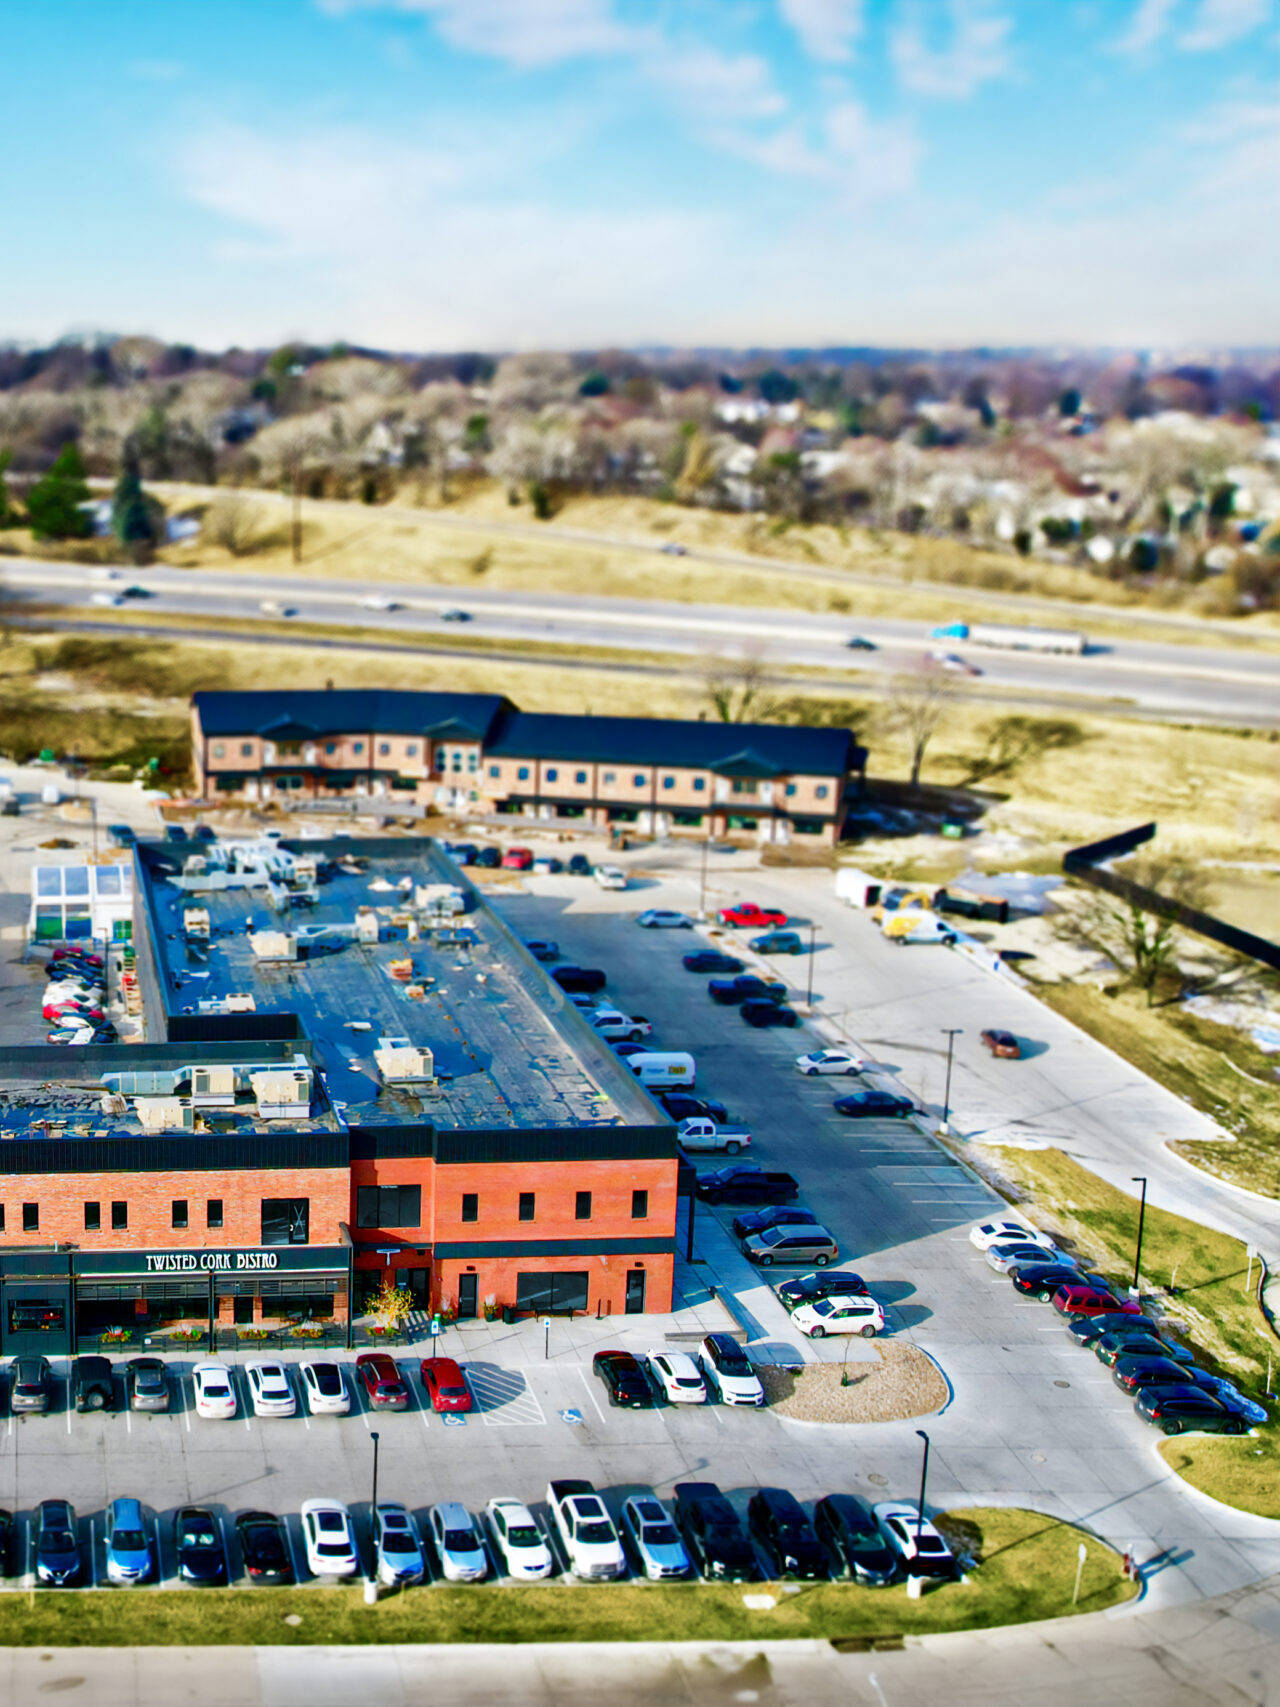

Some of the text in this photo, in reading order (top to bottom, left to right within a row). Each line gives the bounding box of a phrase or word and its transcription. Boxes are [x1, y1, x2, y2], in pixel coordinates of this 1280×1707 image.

[146, 1253, 277, 1270] TWISTED CORK BISTRO
